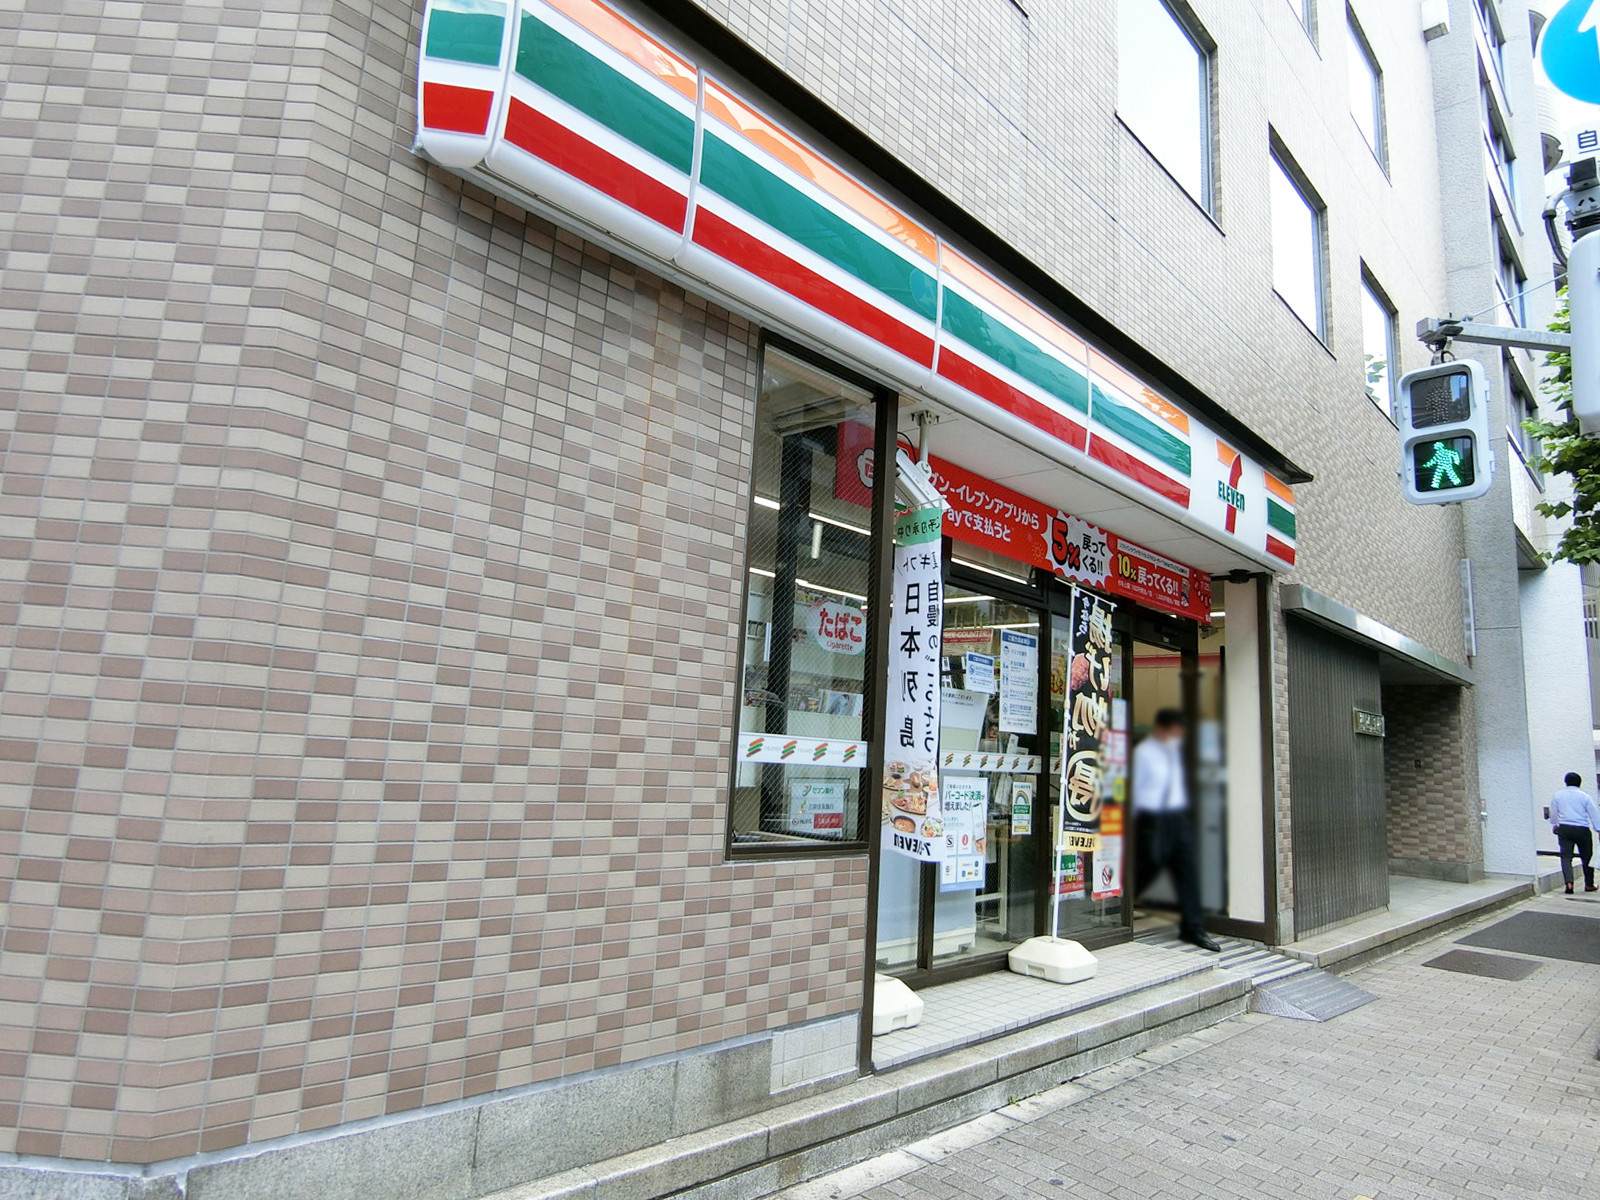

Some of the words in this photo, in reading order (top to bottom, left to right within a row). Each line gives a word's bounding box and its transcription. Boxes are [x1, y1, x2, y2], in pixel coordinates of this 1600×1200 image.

[929, 472, 1040, 531] ブン-イレブンアプリから
[943, 506, 1012, 543] ayで支払うと
[1052, 517, 1081, 572] 5%
[1082, 533, 1106, 557] 戻って
[1082, 555, 1104, 576] くる!!
[1117, 551, 1137, 582] 10%
[1137, 565, 1180, 598] 戻ってくる!!
[818, 607, 863, 643] たばこ
[826, 640, 854, 652] cigarette
